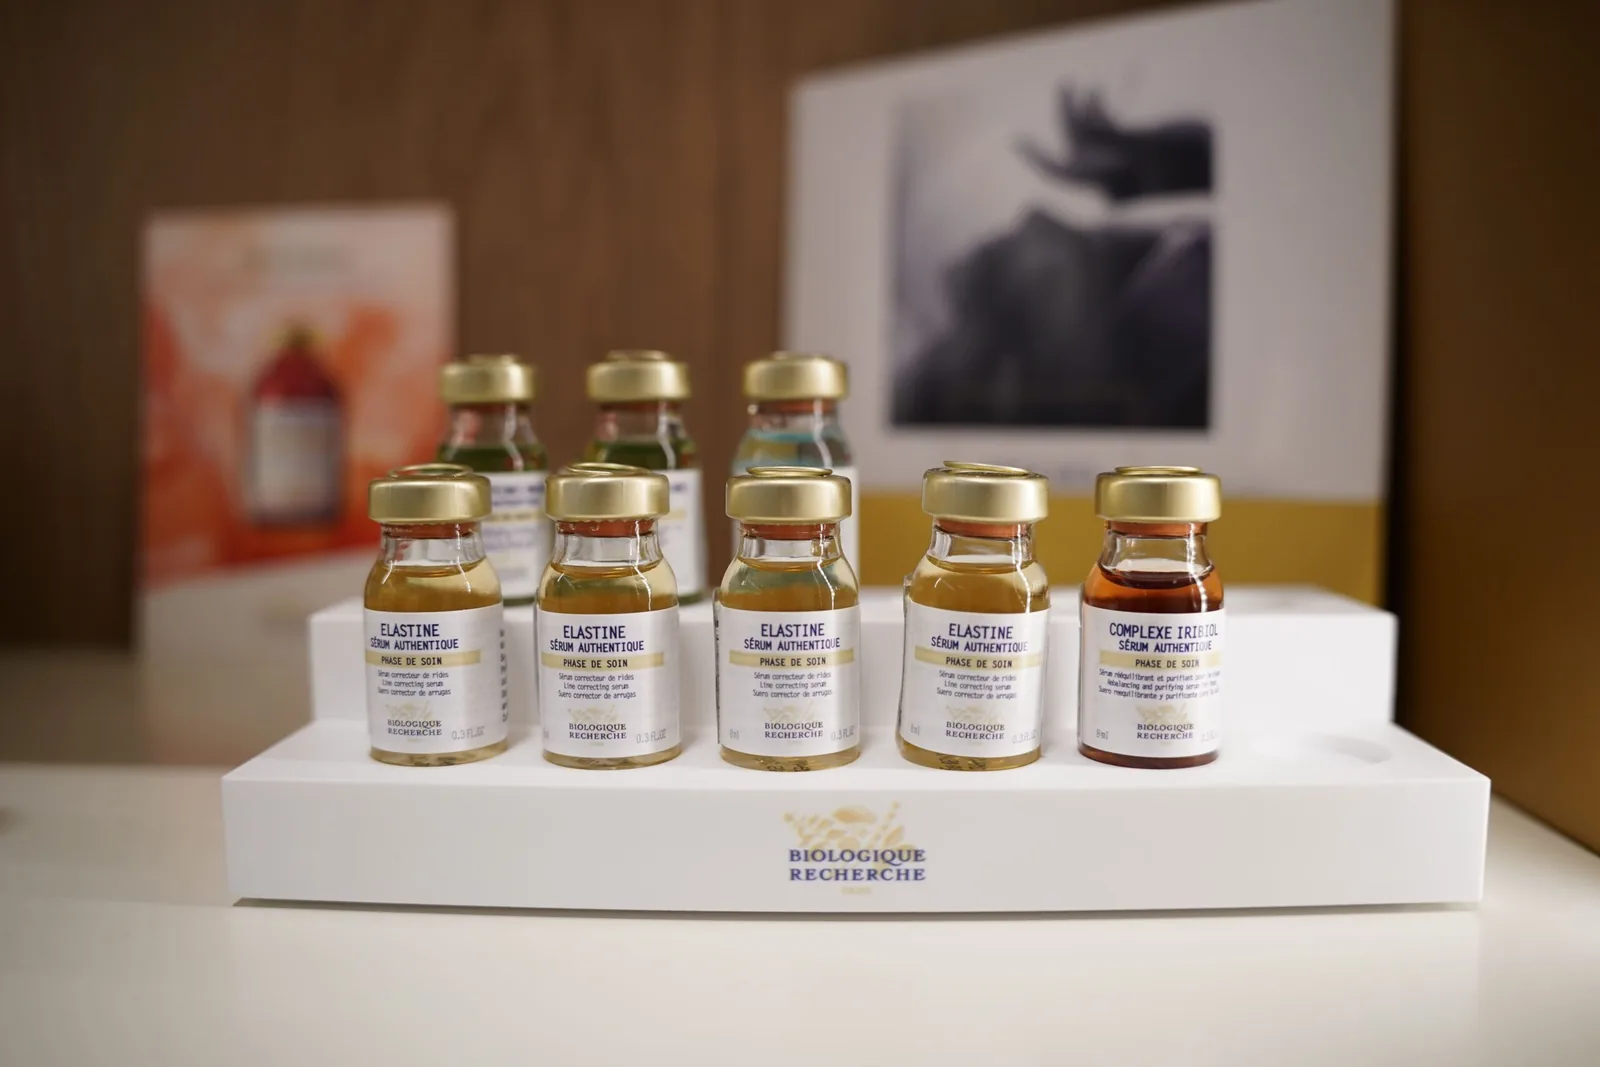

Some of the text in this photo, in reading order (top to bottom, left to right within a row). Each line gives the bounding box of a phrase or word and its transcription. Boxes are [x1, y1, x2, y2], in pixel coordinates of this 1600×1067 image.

[381, 623, 439, 637] ELASTINE
[563, 625, 626, 639] ELASTINE
[761, 623, 825, 637] ELASTINE
[949, 623, 1014, 639] ELASTINE
[1110, 622, 1218, 639] COMPLEXE IRIBIOL
[370, 636, 459, 650] SÉRUM AUTHENTIQUE
[550, 639, 644, 653] SÉRUM AUTHENTIQUE
[744, 637, 840, 651] SÉRUM AUTHENTIQUE
[931, 636, 1028, 652] SÉRUM AUTHENTIQUE
[1119, 640, 1212, 652] SÉRUM AUTHENTIQUE
[381, 656, 442, 665] PHASE DE SOIN
[563, 659, 628, 668] PHASE DE SOIN
[760, 657, 826, 666] PHASE DE SOIN
[946, 656, 1012, 668] PHASE DE SOIN
[1135, 659, 1200, 668] PHASE DE SOIN
[754, 672, 770, 680] Sérum
[939, 670, 955, 679] Sérum
[1114, 671, 1154, 682] rééquilibrant
[944, 680, 958, 688] Line
[960, 682, 993, 690] correcting
[1107, 679, 1140, 690] Rebalancing
[1142, 682, 1152, 690] and
[1155, 683, 1183, 692] purifying
[558, 690, 572, 698] Suero
[937, 687, 952, 696] Suero
[1114, 690, 1157, 700] reequilibrante
[1166, 692, 1198, 700] purificante
[387, 719, 442, 729] BIOLOGIQUE
[569, 723, 626, 732] BIOLOGIQUE
[764, 722, 824, 731] BIOLOGIQUE
[946, 721, 1005, 732] BIOLOGIQUE
[1137, 724, 1194, 732] BIOLOGIQUE
[388, 728, 442, 736] RECHERCHE
[569, 732, 626, 740] RECHERCHE
[765, 730, 823, 738] RECHERCHE
[946, 730, 1005, 740] RECHERCHE
[1137, 732, 1194, 740] RECHERCHE
[789, 849, 926, 867] BIOLOGIQUE
[789, 868, 926, 881] RECHERCHE
